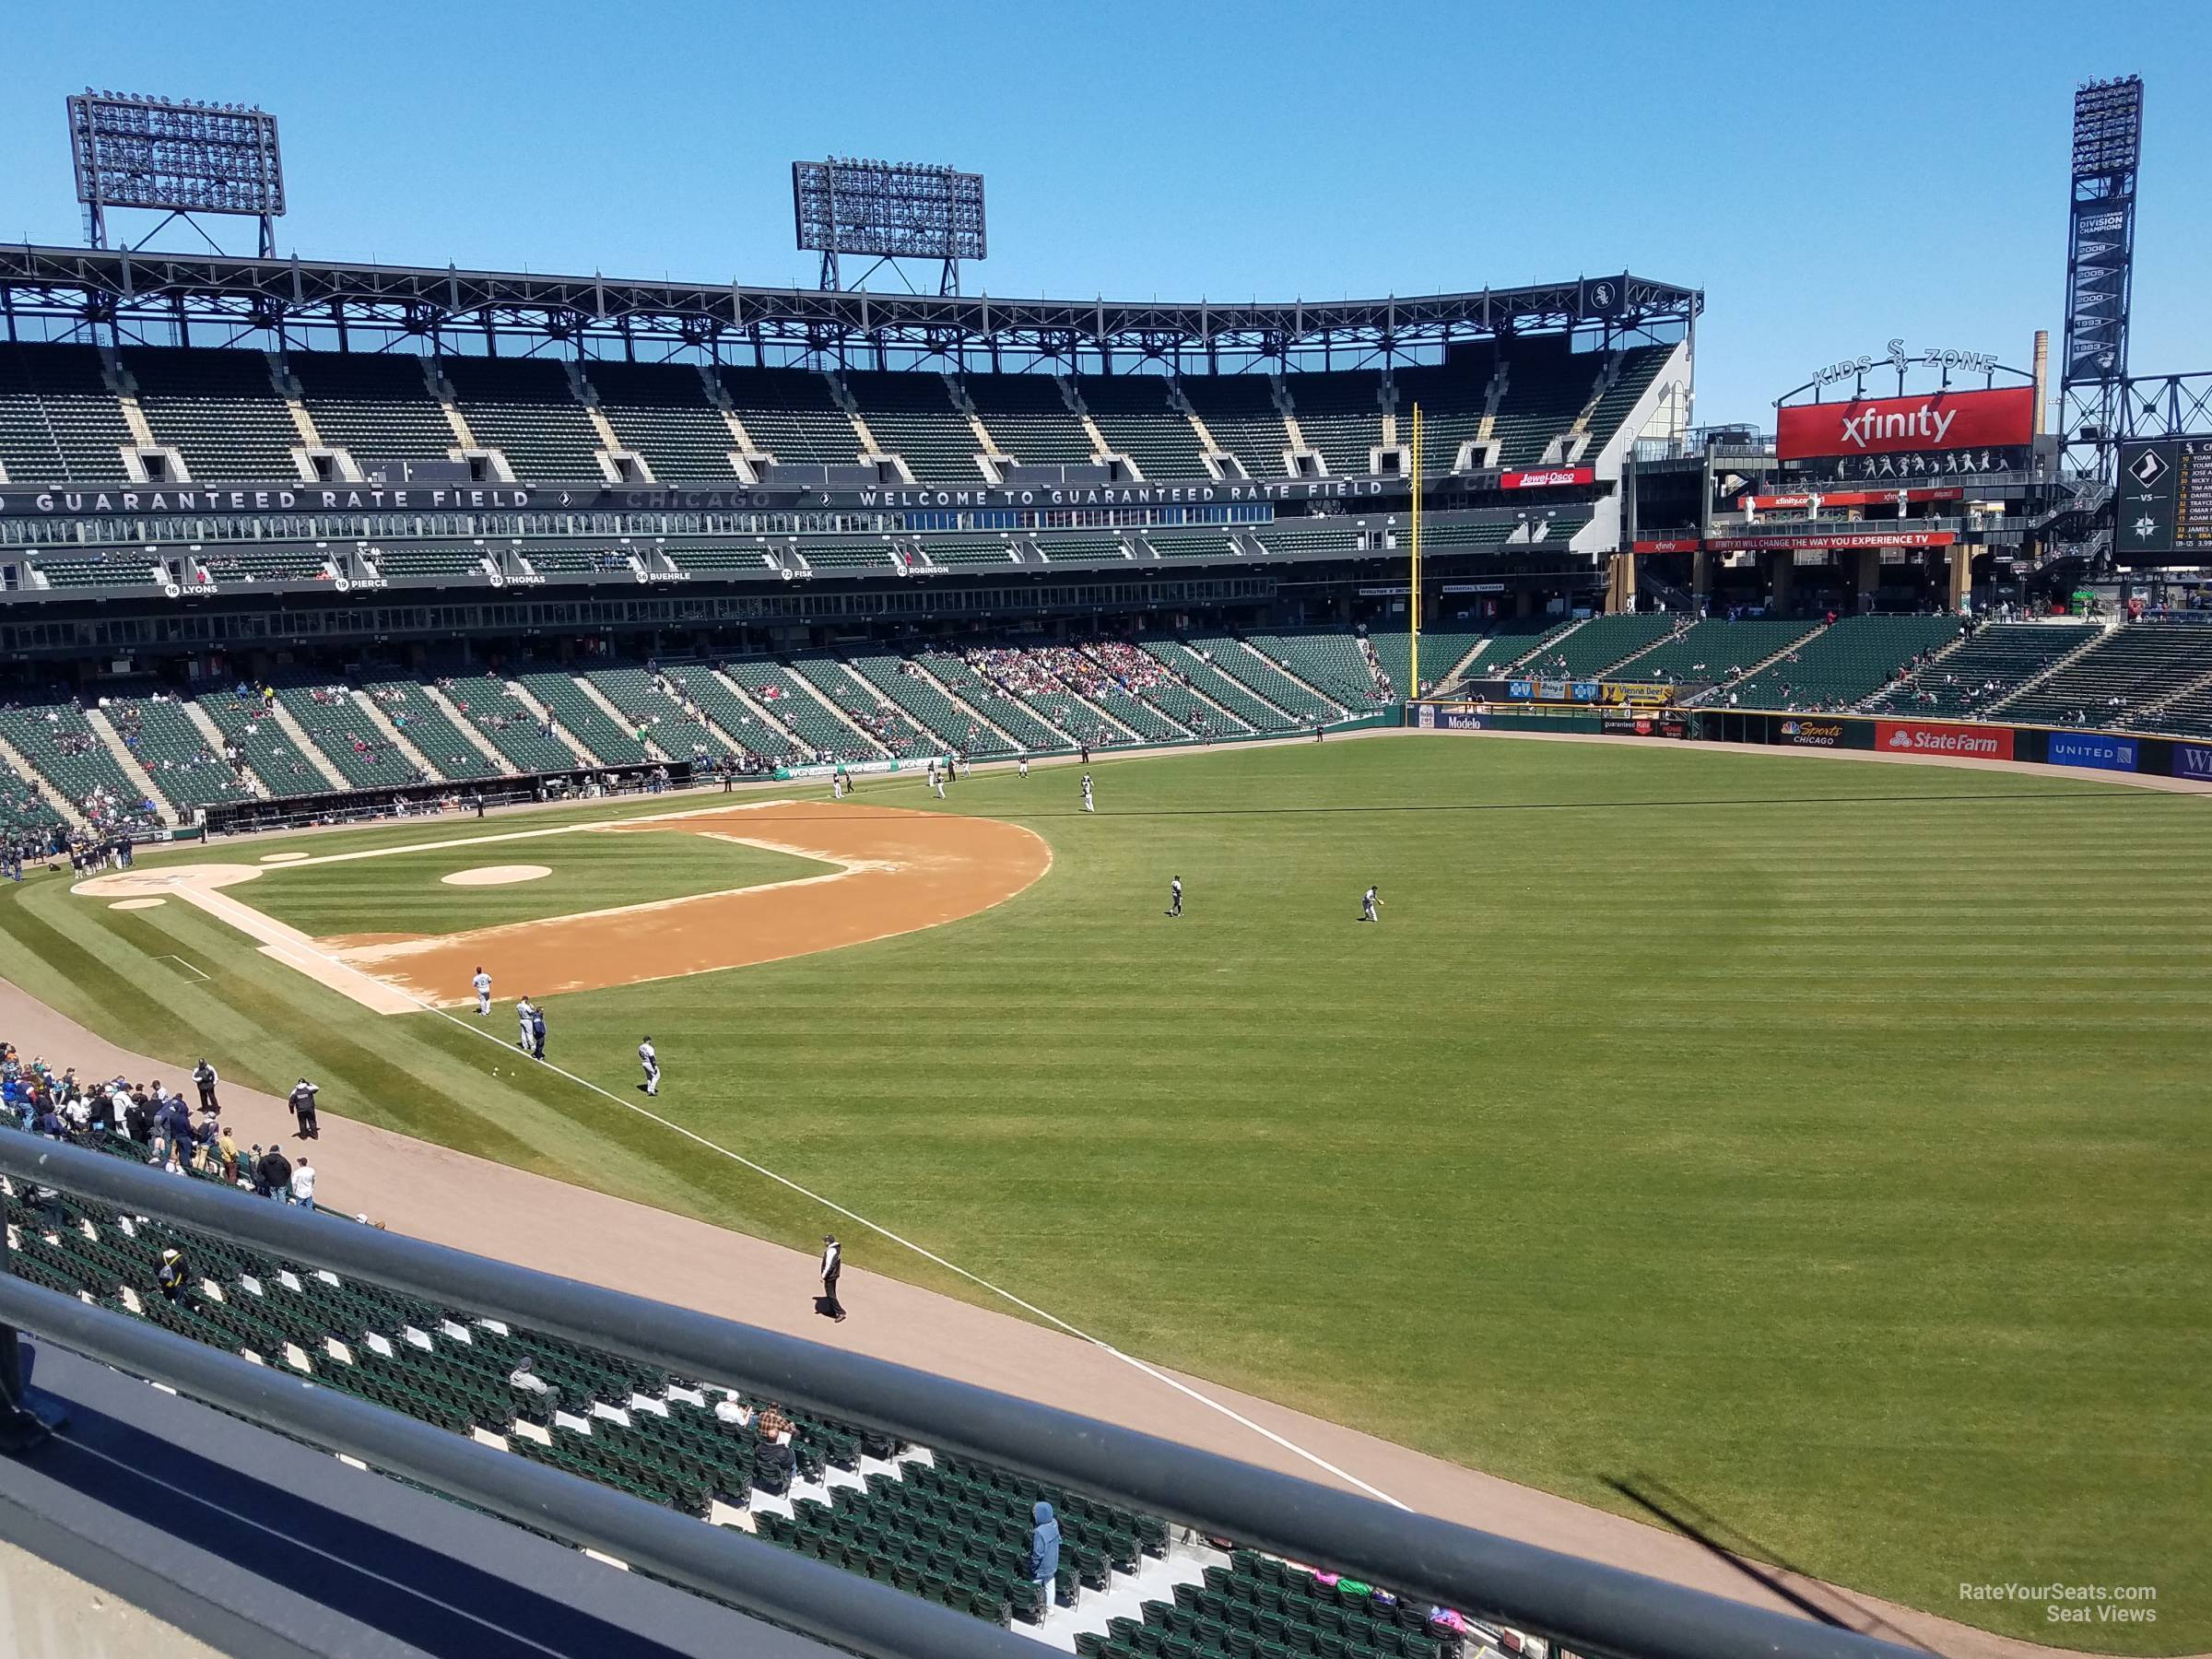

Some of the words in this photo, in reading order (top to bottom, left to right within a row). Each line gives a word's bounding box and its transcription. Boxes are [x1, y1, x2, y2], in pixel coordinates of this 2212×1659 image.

[2079, 217, 2123, 228] DIVISION
[2079, 224, 2122, 234] CHAMPIONS
[2079, 245, 2105, 253] 2008
[2077, 270, 2104, 278] 2005
[2077, 295, 2103, 303] 2000
[2077, 319, 2101, 327] 1993
[1813, 355, 1873, 388] KIDS
[1923, 348, 1998, 374] ZONE
[1841, 404, 1956, 448] xfinity
[1523, 472, 1575, 483] Jewel-Osco
[626, 492, 770, 507] CHICAGO
[859, 490, 986, 506] WELCOME
[1005, 491, 1033, 505] TO
[1052, 487, 1214, 504] GUARANTEED
[1231, 486, 1289, 500] RATE
[1308, 483, 1382, 497] FIELD
[36, 492, 295, 511] GUARANTEED
[323, 491, 408, 507] RATE
[432, 491, 528, 507] FIELD
[1742, 539, 1758, 547] WILL
[1759, 538, 1789, 547] CHANGE
[1792, 537, 1807, 546] THE
[1809, 537, 1829, 546] WAY
[1830, 536, 1850, 546] YOU
[1853, 535, 1912, 545] EXPERIENCE
[1915, 535, 1928, 544] TV
[1654, 542, 1676, 551] xfinity
[794, 570, 813, 578] FISK
[910, 566, 948, 574] ROBINSON
[506, 575, 546, 584] THOMAS
[650, 572, 690, 581] BUEHRLE
[182, 584, 218, 594] LYONS
[351, 579, 388, 589] PIERCE
[1619, 686, 1644, 694] Vienna
[1647, 687, 1663, 695] Beef
[1448, 716, 1480, 729] Modelo
[1799, 722, 1842, 737] Sports
[1794, 735, 1834, 745] CHICAGO
[2055, 745, 2113, 759] UNITED
